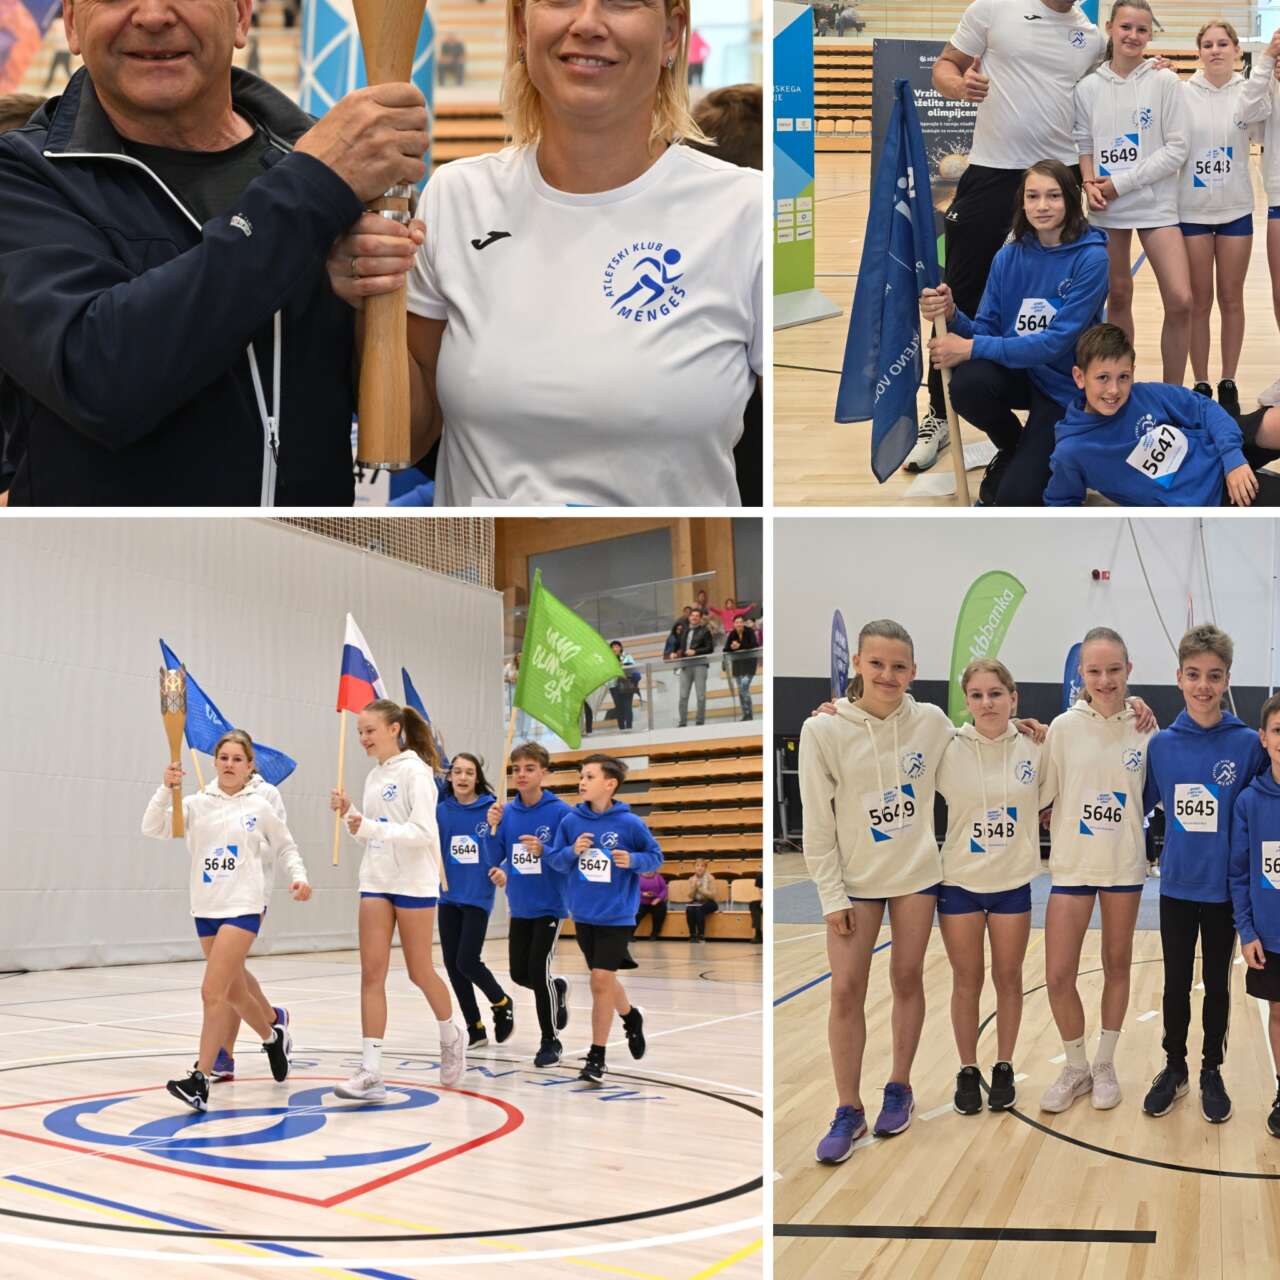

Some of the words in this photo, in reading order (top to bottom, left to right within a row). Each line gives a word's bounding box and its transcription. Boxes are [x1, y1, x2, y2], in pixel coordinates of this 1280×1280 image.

[775, 85, 801, 93] SKEGA
[1101, 147, 1138, 164] 5649
[603, 248, 630, 297] ATLETSKI
[632, 241, 663, 253] KLUB
[616, 285, 686, 322] MENGEŠ
[1142, 426, 1176, 475] 5647
[1083, 804, 1122, 823] 5646
[1176, 800, 1215, 816] 5645
[452, 844, 477, 855] 5644
[580, 858, 609, 871] 5647
